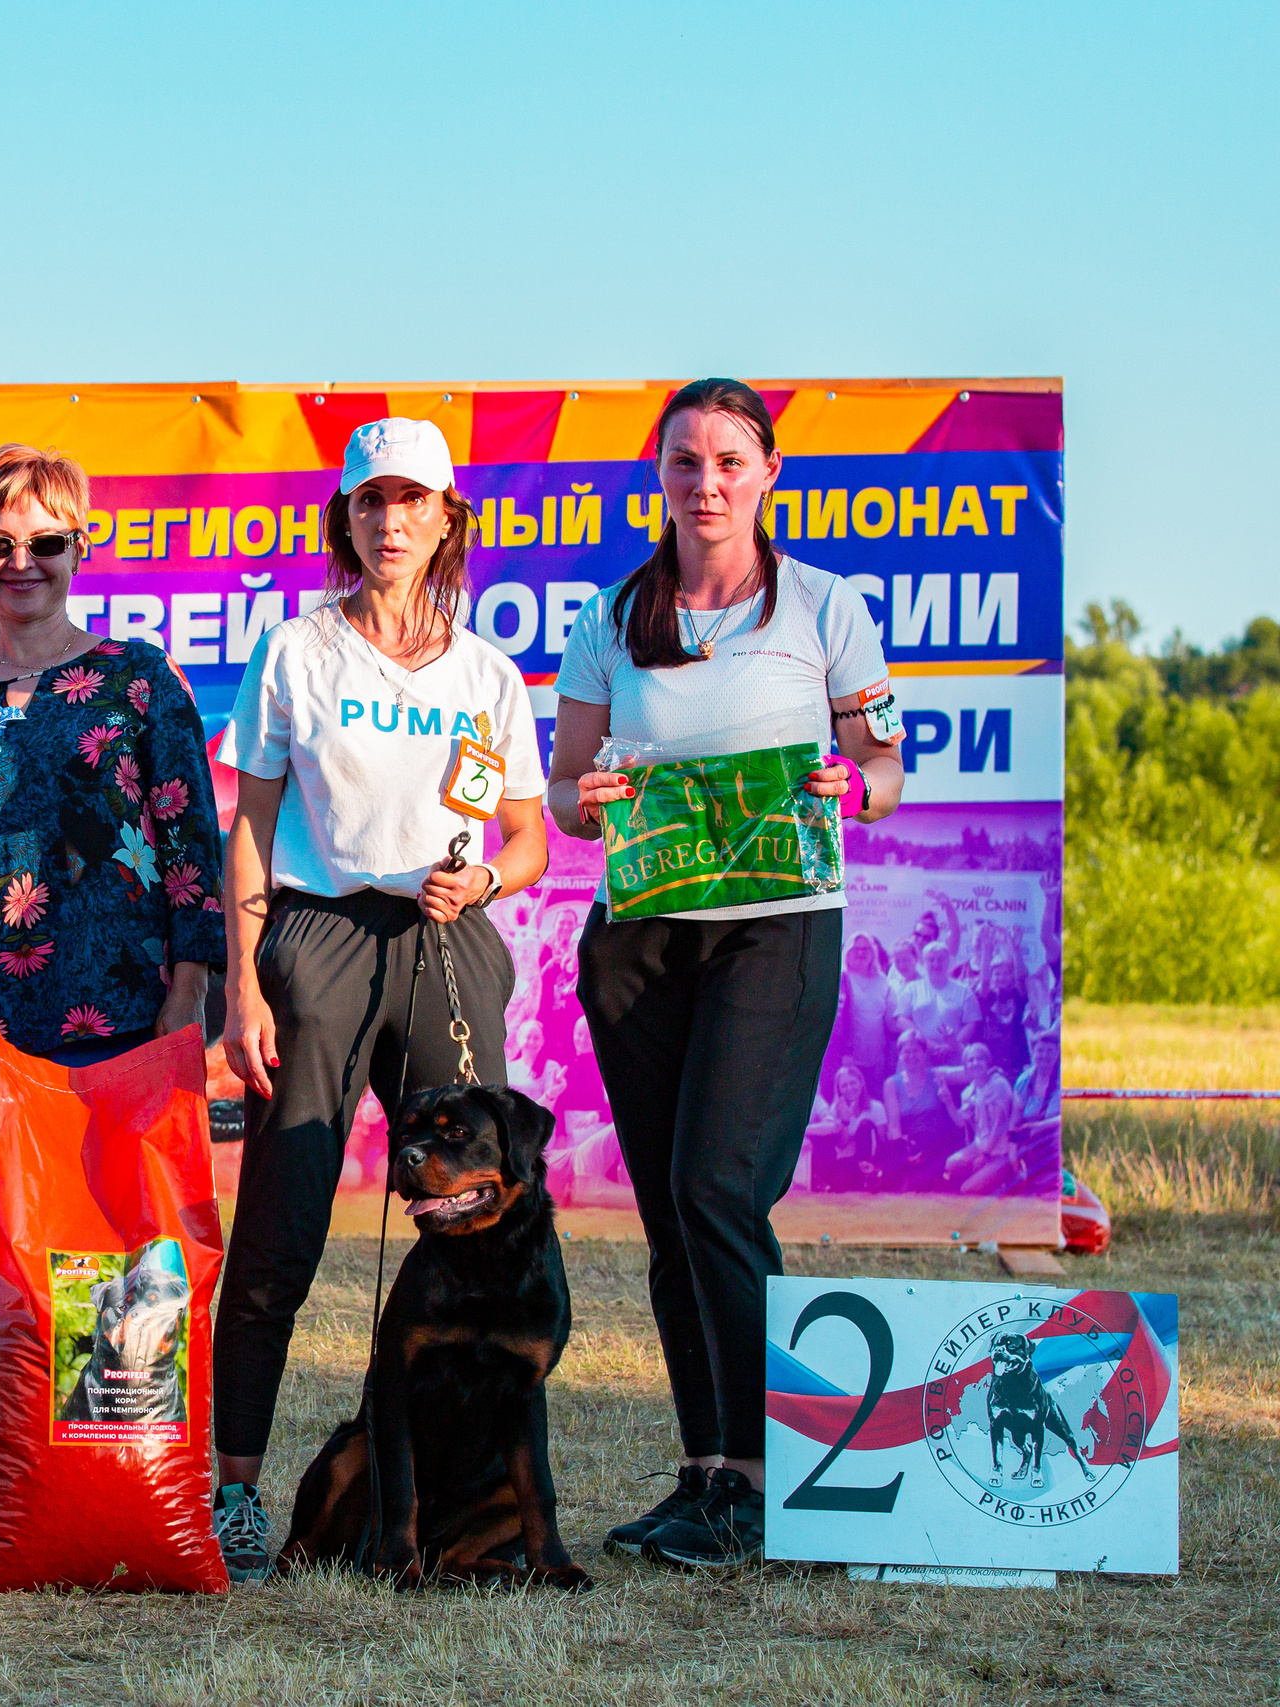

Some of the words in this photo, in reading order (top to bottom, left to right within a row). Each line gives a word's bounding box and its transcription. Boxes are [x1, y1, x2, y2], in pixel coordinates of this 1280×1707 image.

[340, 698, 479, 741] PUMA
[462, 762, 489, 803] 3
[616, 837, 736, 890] BEREGA
[104, 1369, 150, 1379] PROFIFEED
[928, 1304, 1011, 1462] РОТВЕЙЛЕР
[1028, 1301, 1100, 1341] КЛУБ
[1107, 1348, 1143, 1470] РОССИИ
[87, 1387, 164, 1396] ПОЛНОРАЦИОННЫЙ
[783, 1291, 905, 1513] 2
[92, 1406, 110, 1414] ДЛЯ
[68, 1423, 149, 1431] ПРОФЕССИОНАЛЬНЫЙ
[978, 1491, 1099, 1524] РКФ-НКПР
[891, 1564, 926, 1575] Корма
[928, 1566, 963, 1576] нового
[965, 1569, 1018, 1577] поколения
